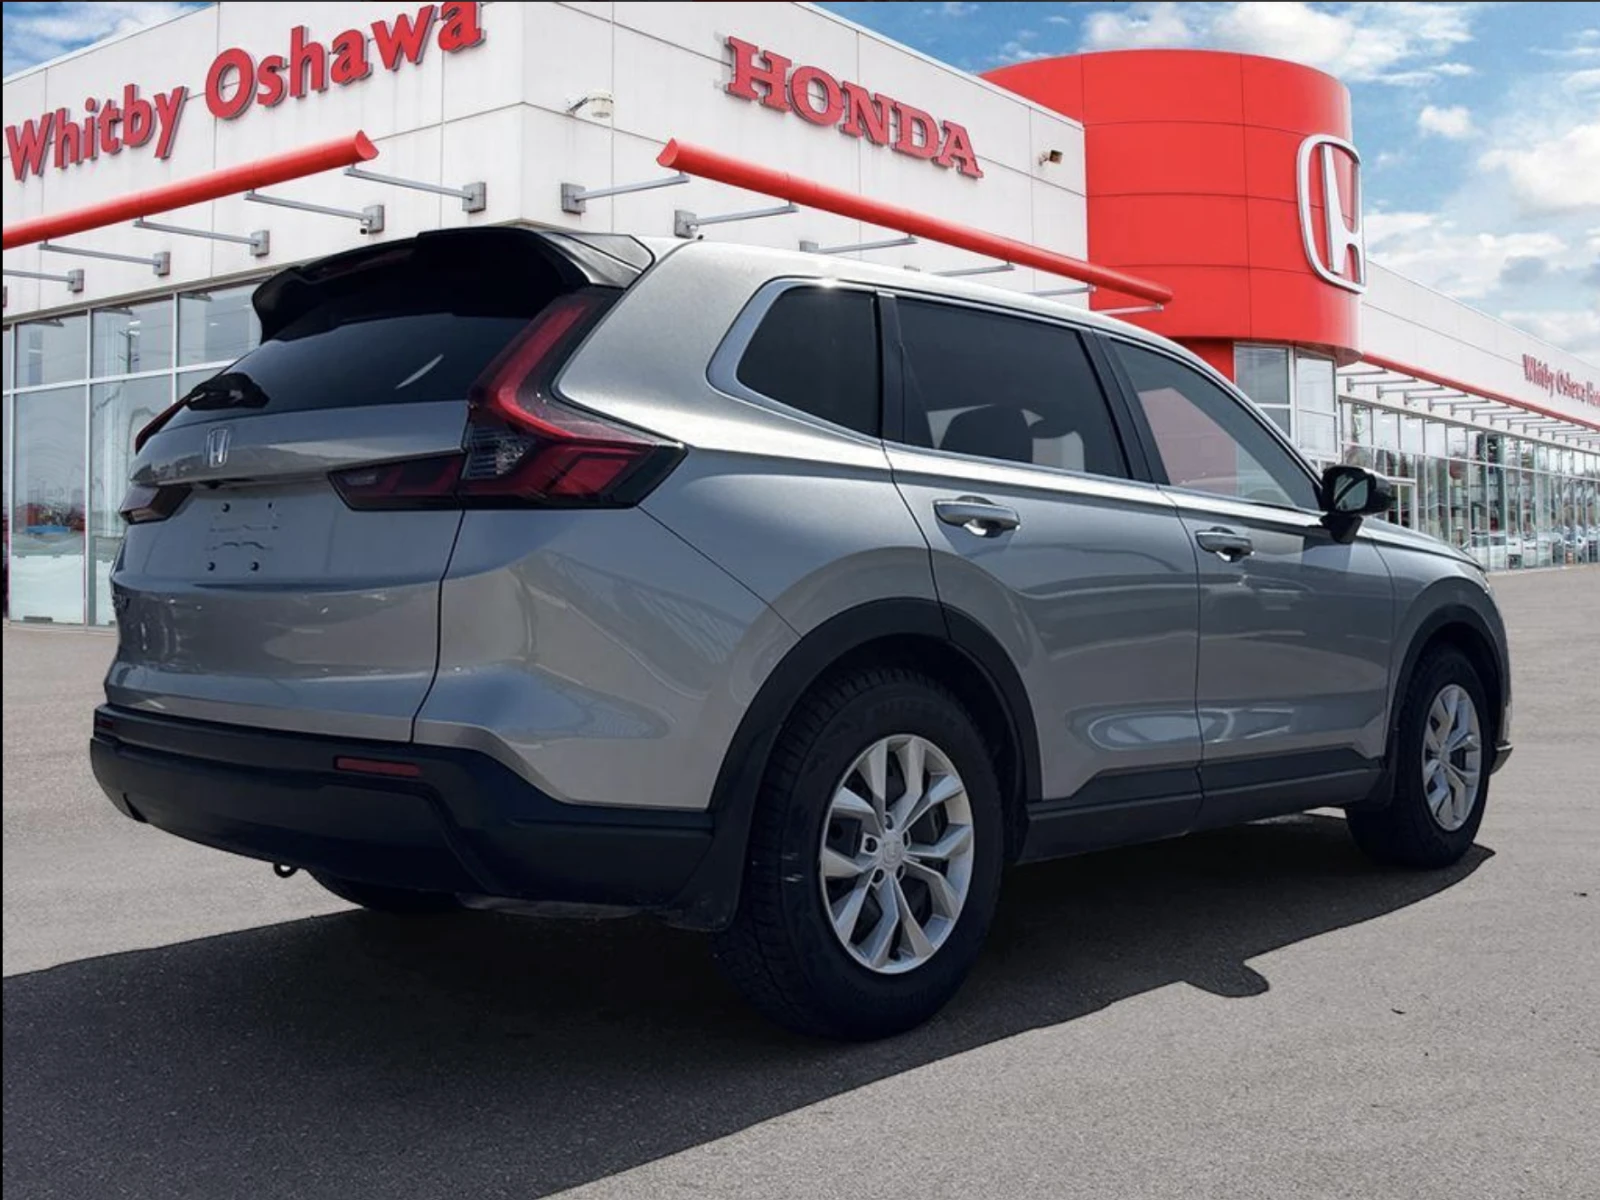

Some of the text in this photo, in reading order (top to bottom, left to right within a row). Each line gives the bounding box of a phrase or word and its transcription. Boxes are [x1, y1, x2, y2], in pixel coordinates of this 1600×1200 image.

[5, 2, 487, 182] Whitby Oshawa
[725, 36, 983, 179] HONDA
